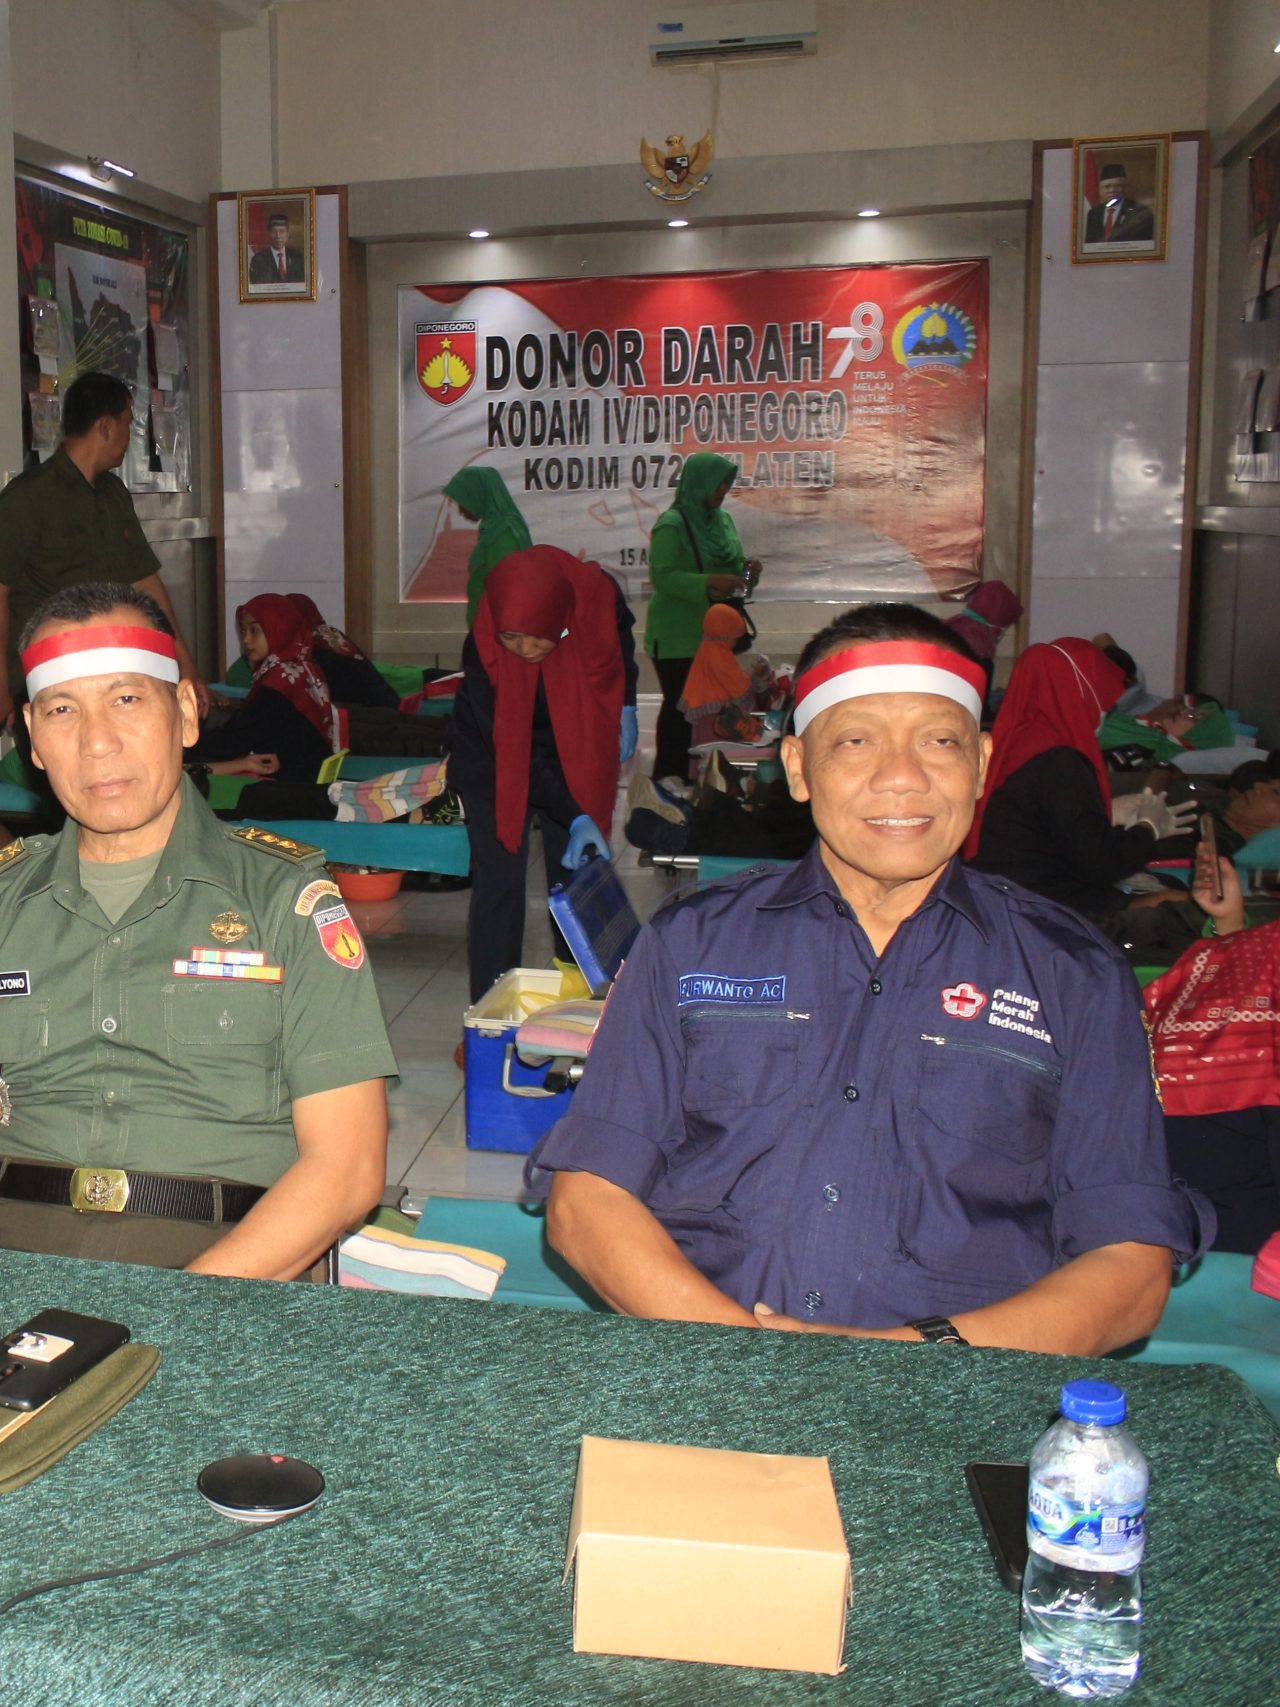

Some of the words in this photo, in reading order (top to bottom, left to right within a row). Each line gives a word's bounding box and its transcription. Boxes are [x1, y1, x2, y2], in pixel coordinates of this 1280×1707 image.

[417, 322, 475, 333] DIPONEGORO
[484, 328, 646, 393] DONOR
[661, 321, 823, 387] DARAH
[853, 370, 887, 380] TERUS
[853, 382, 895, 391] MELAJU
[853, 394, 887, 403] UNTUK
[487, 398, 591, 449] KODAM
[603, 389, 849, 446] IV/DIPONEGORO
[523, 455, 620, 492] KODIM
[631, 453, 688, 491] 072
[620, 548, 635, 566] 15
[760, 983, 781, 998] AC
[992, 988, 1040, 1012] Palang
[991, 1000, 1035, 1022] Merah
[988, 1012, 1053, 1044] Indonesia
